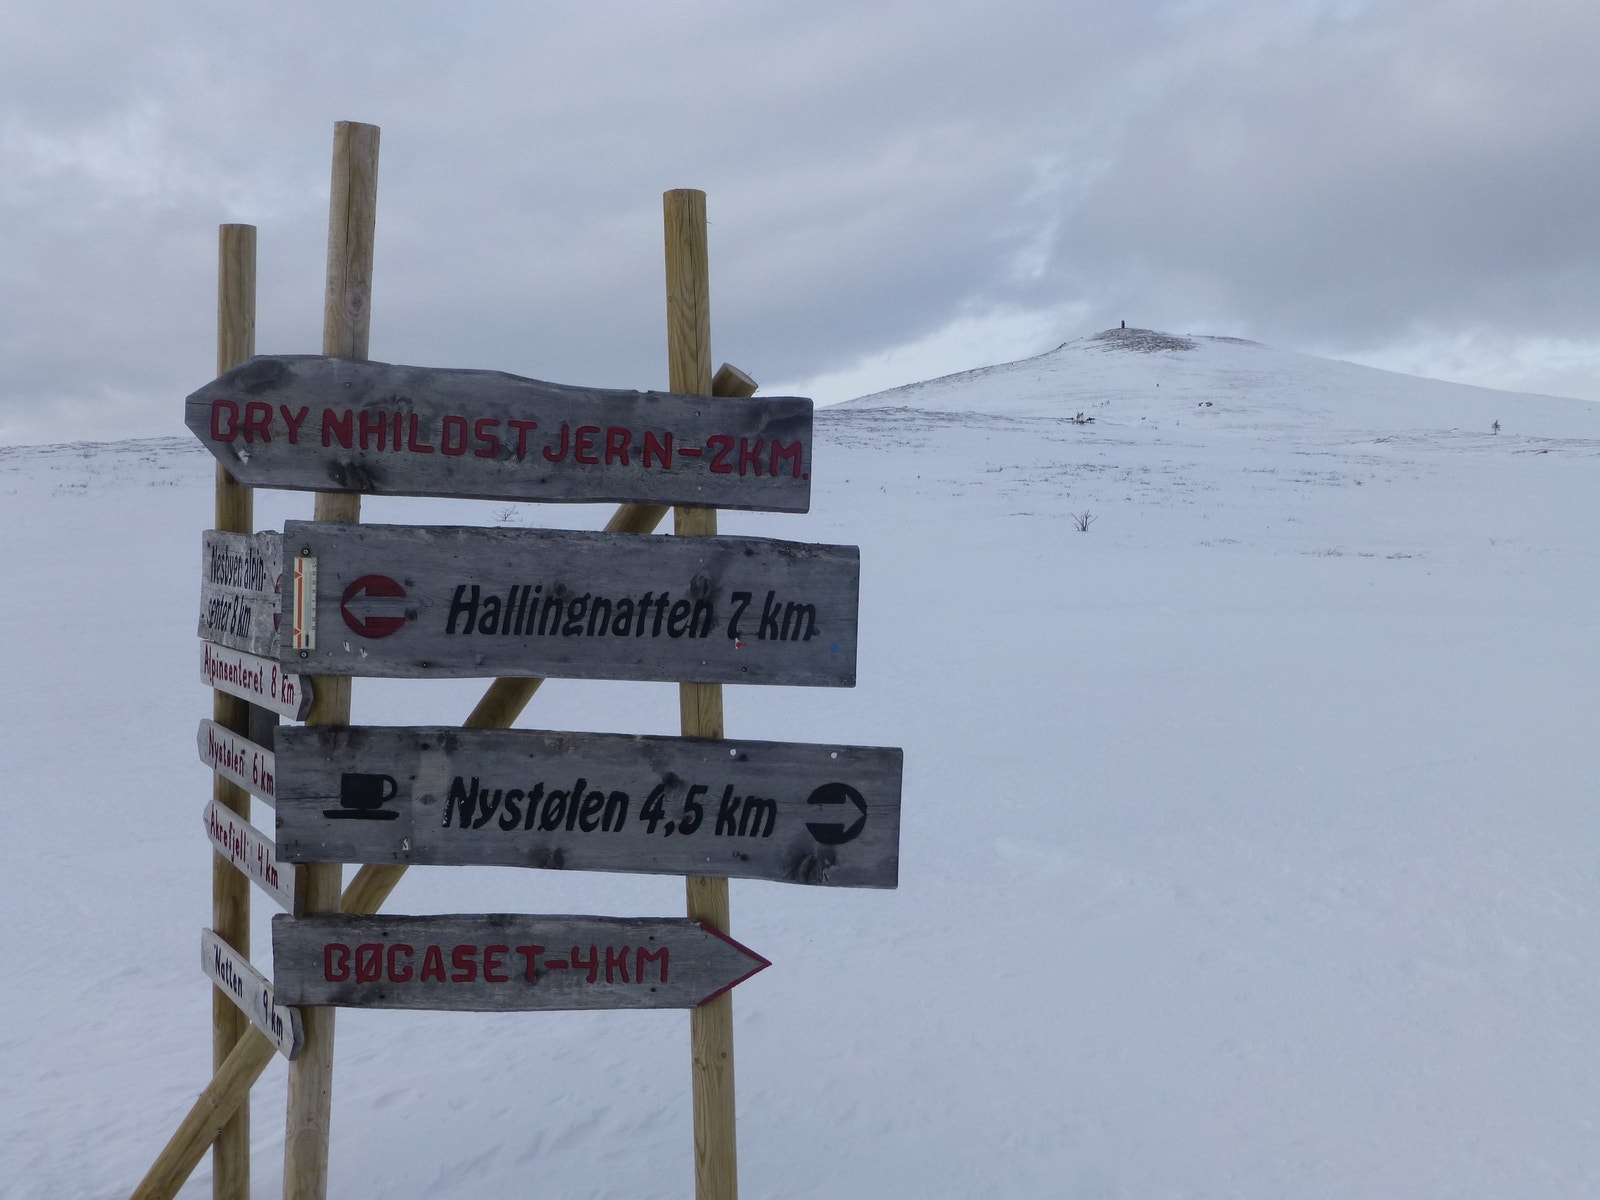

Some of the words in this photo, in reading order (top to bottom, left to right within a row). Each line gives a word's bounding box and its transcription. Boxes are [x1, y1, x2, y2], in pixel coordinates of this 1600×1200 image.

[230, 594, 239, 635] 8
[237, 595, 252, 638] km
[446, 584, 714, 639] Hallingnatten
[726, 591, 752, 640] 7
[758, 590, 817, 642] km
[204, 644, 264, 694] Alpinsenteret
[270, 664, 278, 699] 8
[280, 673, 295, 706] km
[208, 726, 245, 778] Nystølen
[252, 752, 259, 786] 6
[260, 754, 274, 797] km
[441, 776, 630, 833] Nystølen
[639, 783, 709, 838] 4,5
[714, 783, 778, 838] km
[257, 842, 264, 878] 4
[265, 849, 279, 890] km
[213, 944, 243, 999] Natten
[262, 989, 269, 1025] 9
[271, 996, 283, 1041] km
